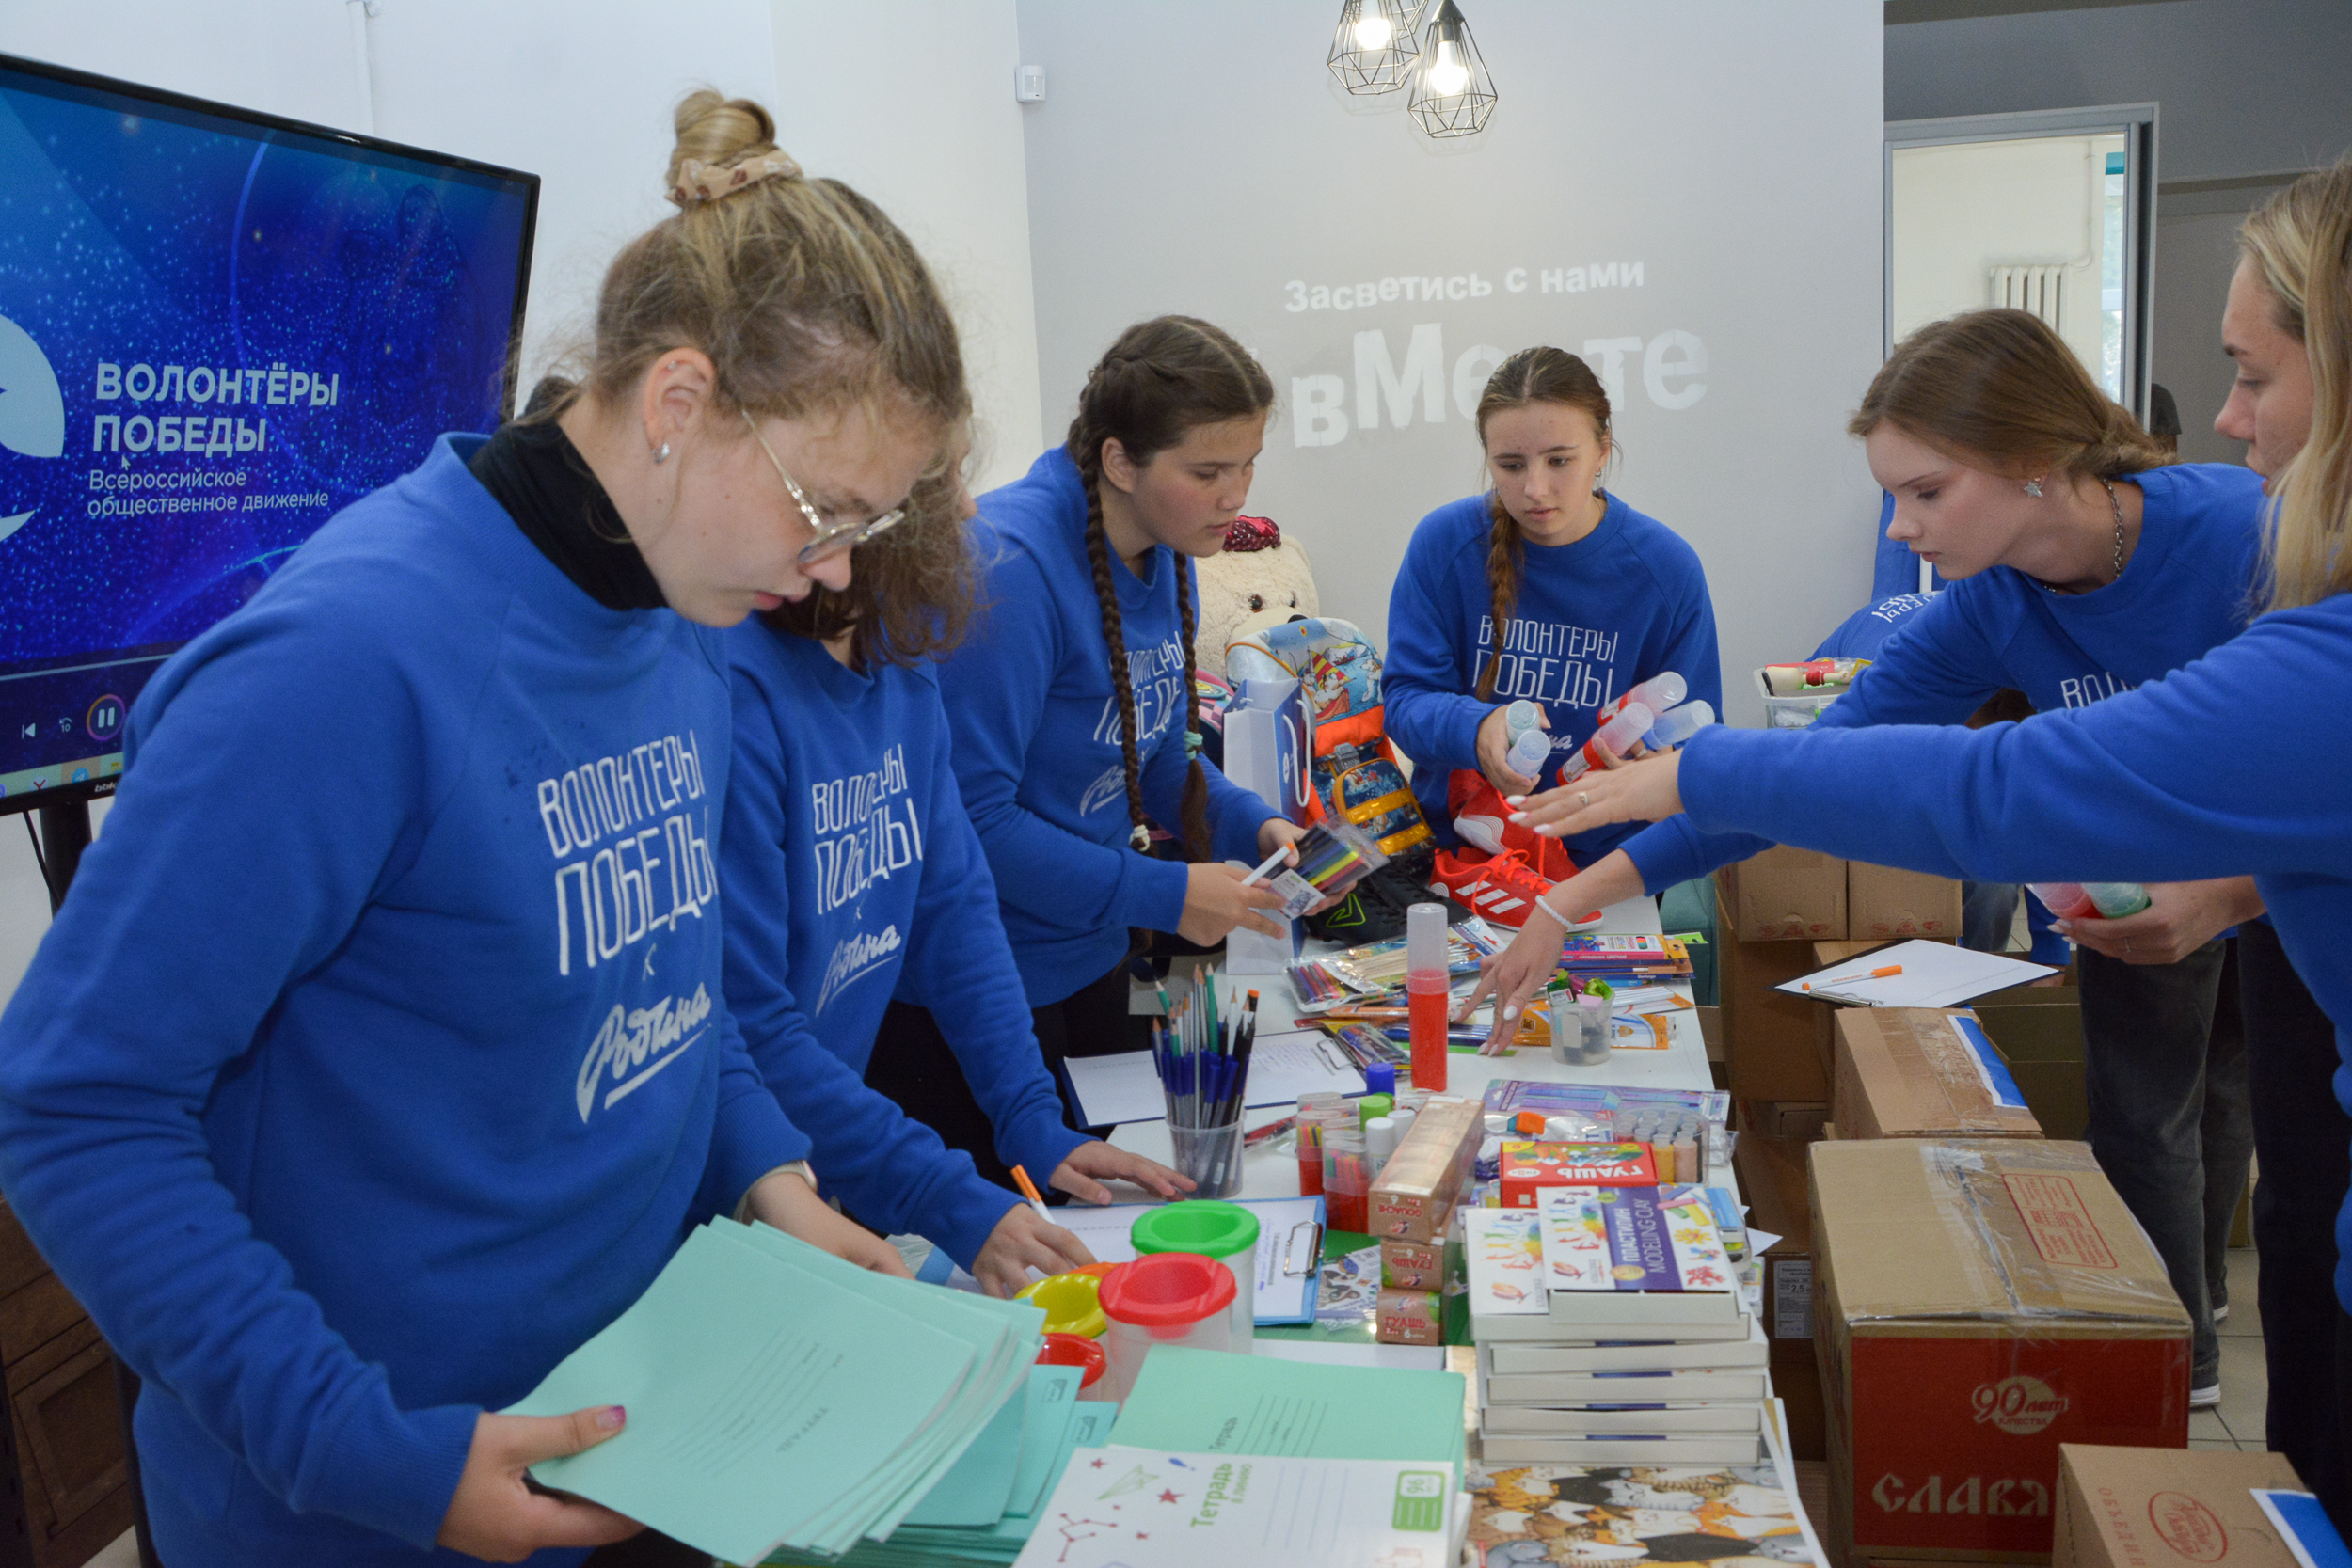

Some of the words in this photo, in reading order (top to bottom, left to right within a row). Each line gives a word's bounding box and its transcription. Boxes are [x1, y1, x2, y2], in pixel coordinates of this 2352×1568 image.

[1284, 273, 1492, 312] Засветись
[1505, 267, 1528, 293] с
[1541, 261, 1645, 293] нами
[96, 363, 339, 405] ВОЛОНТЁРЫ
[1291, 323, 1708, 448] вМете
[93, 414, 266, 457] ПОБЕДЫ
[89, 469, 246, 493] Всероссийское
[87, 491, 238, 517] общественное
[242, 489, 328, 513] движение
[537, 729, 705, 859] ВОЛОНТЕРЫ
[555, 805, 718, 976] ПОБЕДЫ
[576, 982, 712, 1124] Родина
[1556, 1166, 1644, 1180] ГУАШЬ
[1378, 1204, 1422, 1217] GOUACHE
[1391, 1194, 1399, 1204] 6
[1634, 1198, 1655, 1217] CLAY
[1613, 1208, 1642, 1262] ПЛАСТИЛИН
[1637, 1218, 1667, 1274] MODELLING
[1392, 1258, 1433, 1270] ГУАШЬ
[1406, 1249, 1414, 1258] 6
[1791, 1284, 1804, 1293] 2,5
[1385, 1317, 1426, 1329] ГУАШЬ
[1404, 1329, 1411, 1338] 6
[1975, 1383, 2026, 1423] 90
[1190, 1463, 1234, 1528] Тетрадь
[1233, 1464, 1253, 1497] линию
[1406, 1477, 1425, 1495] 96
